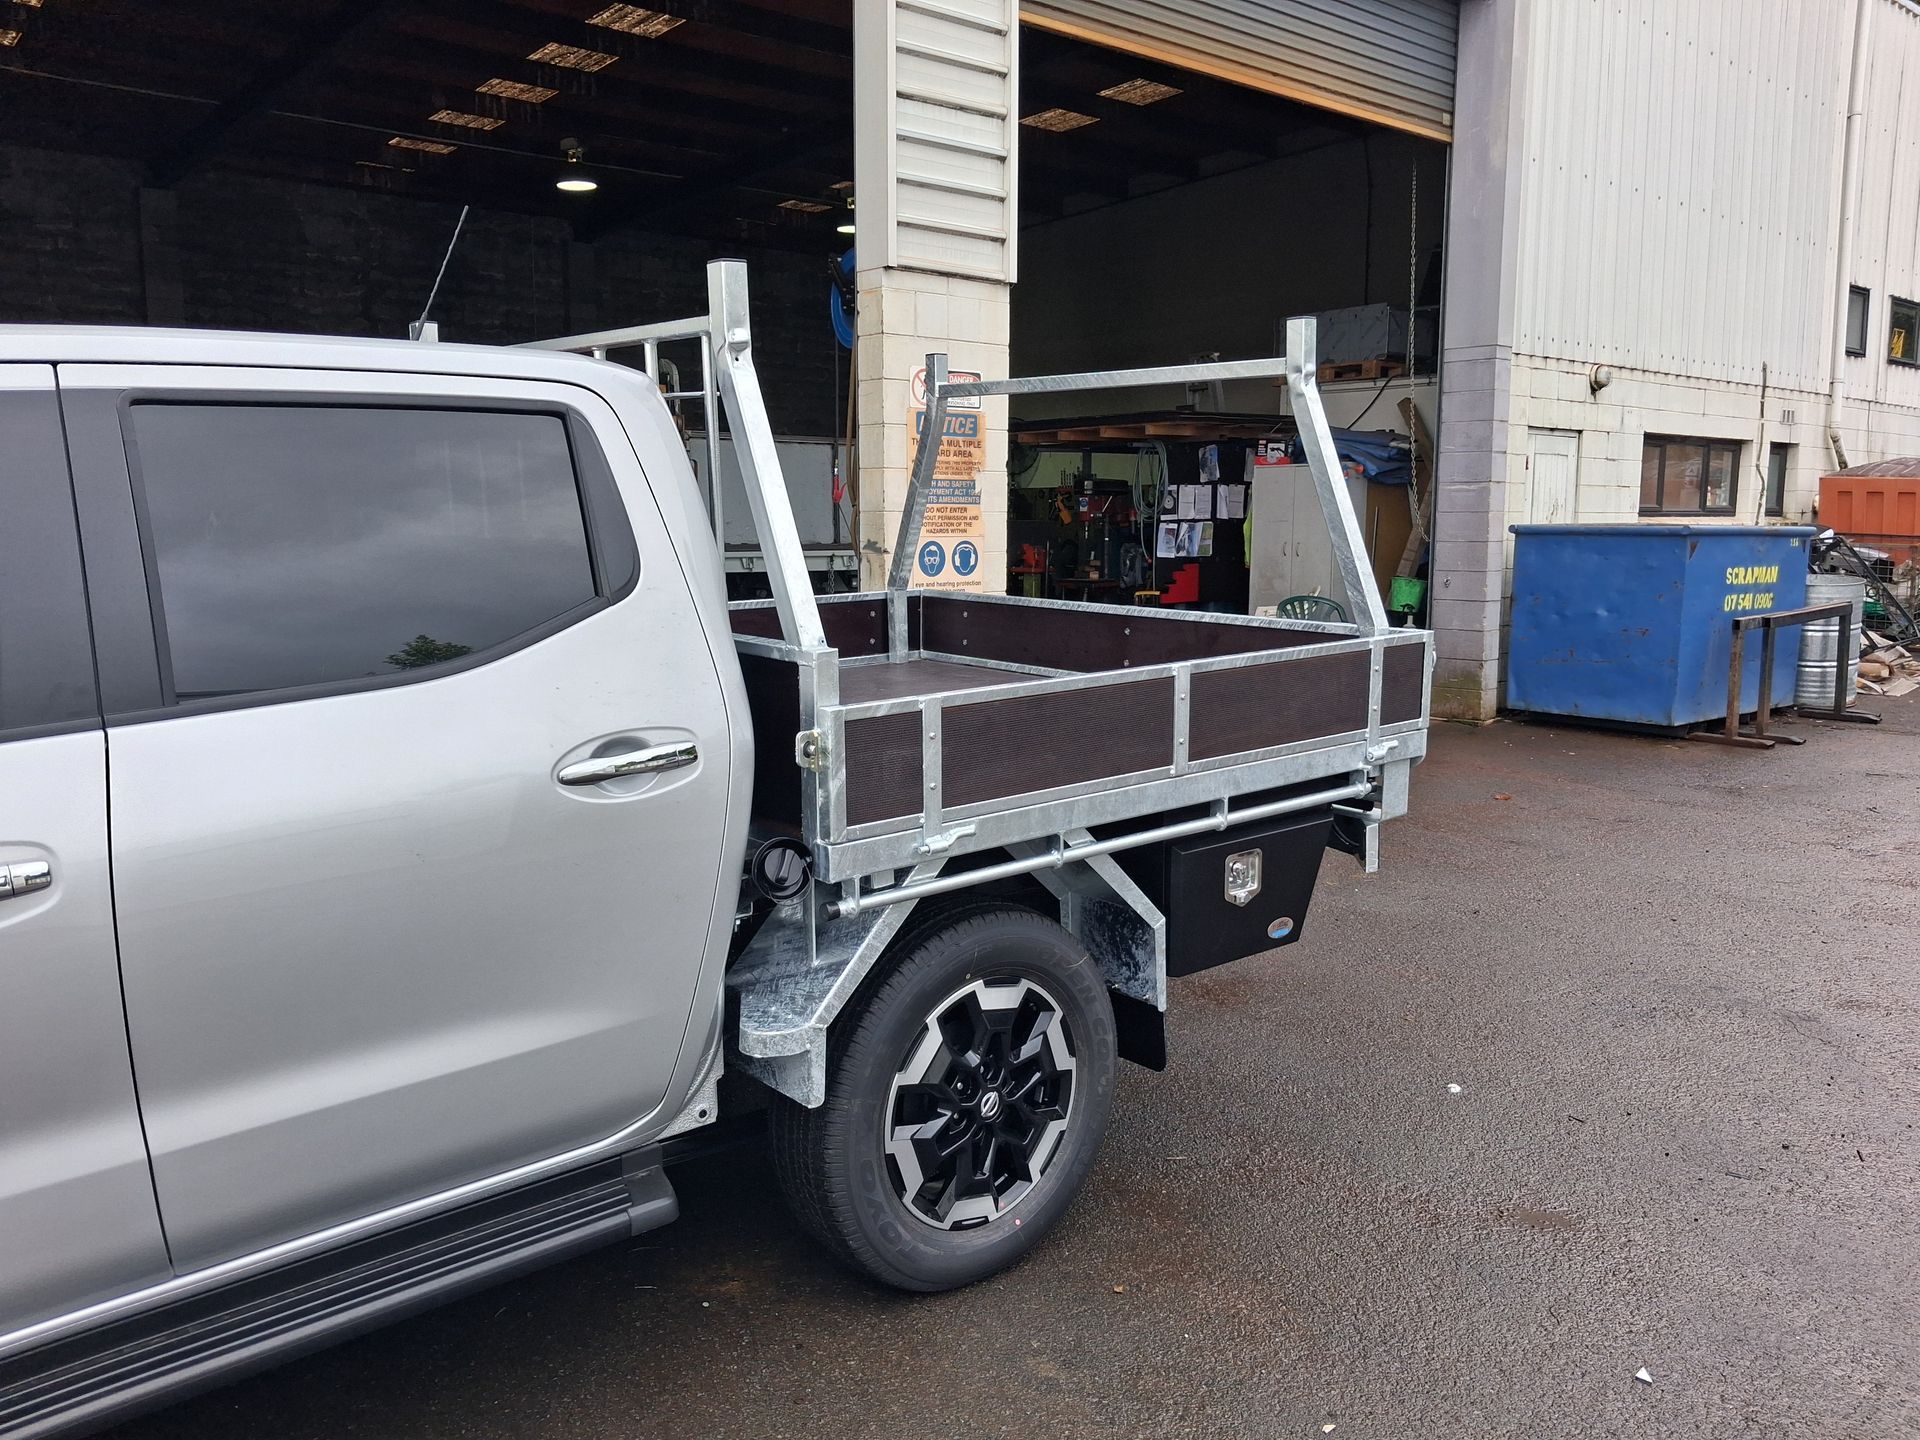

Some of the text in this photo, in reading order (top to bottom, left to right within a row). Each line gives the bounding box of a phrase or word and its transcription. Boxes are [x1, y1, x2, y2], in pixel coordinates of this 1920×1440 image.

[947, 440, 982, 449] MULTIPLE
[953, 450, 973, 458] AREA
[1725, 566, 1779, 585] SCRAPMAN
[956, 580, 982, 588] protection
[1724, 594, 1738, 612] 07
[1737, 593, 1753, 611] 541
